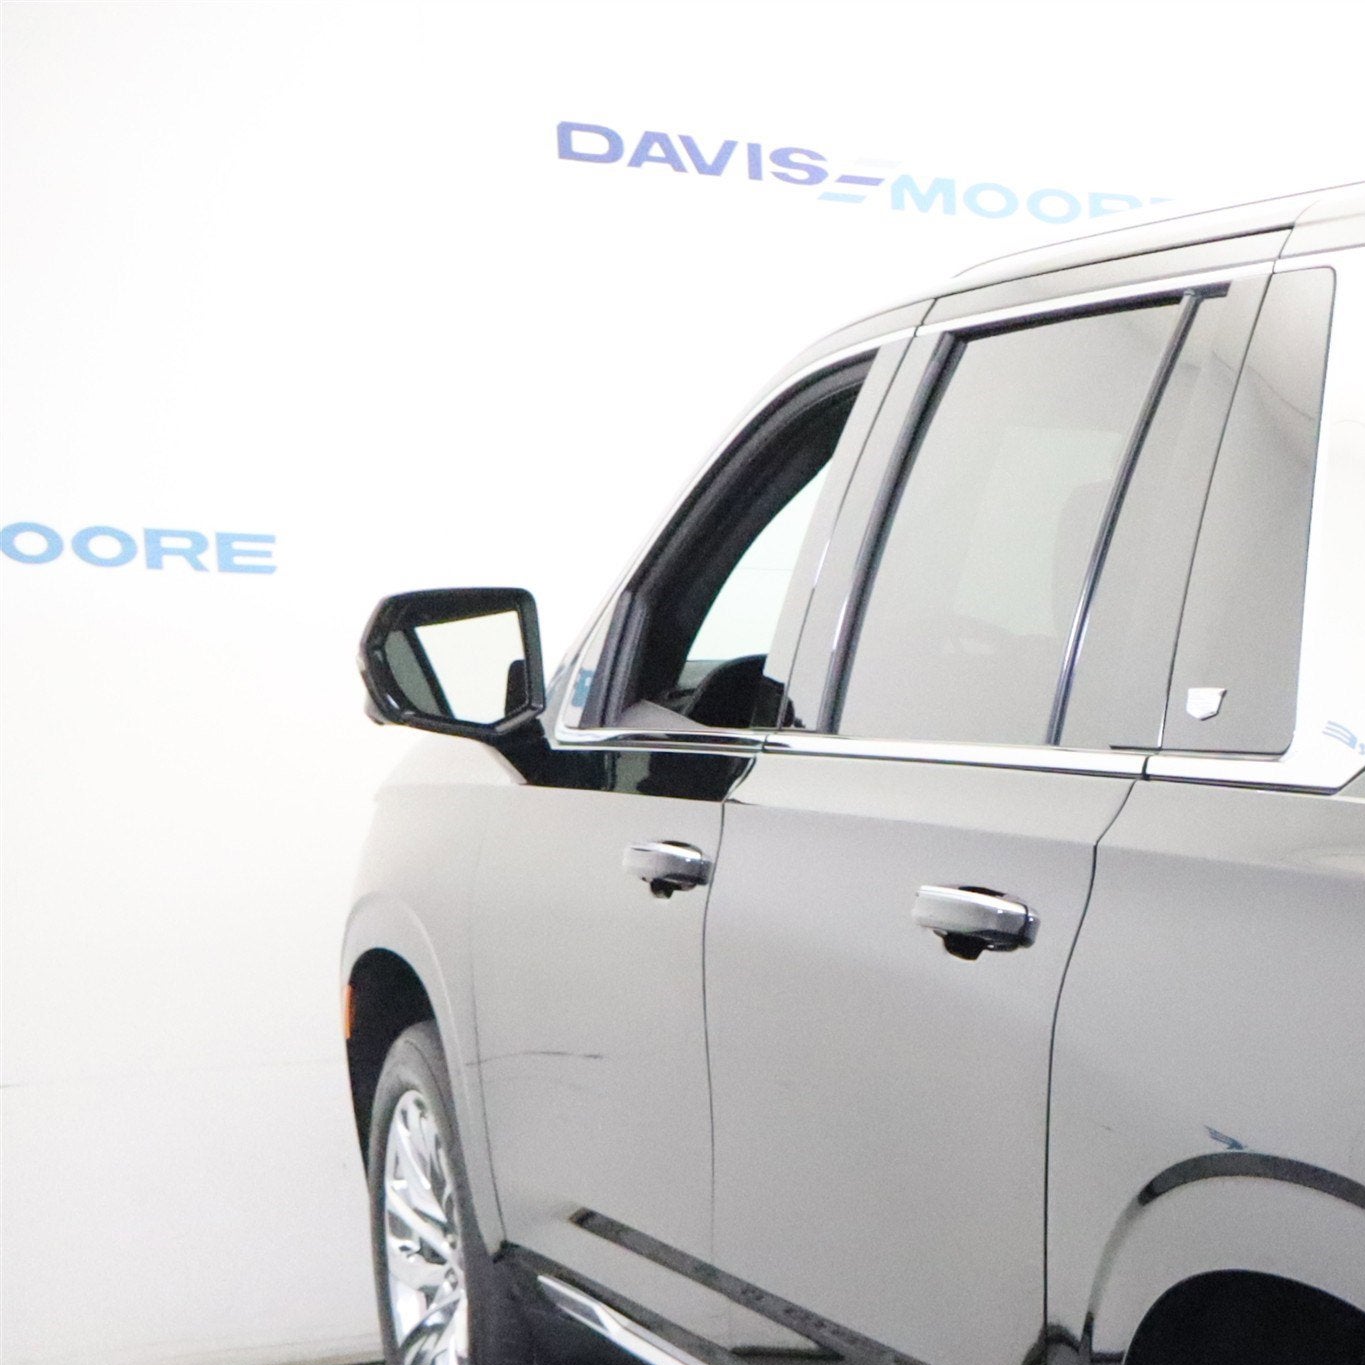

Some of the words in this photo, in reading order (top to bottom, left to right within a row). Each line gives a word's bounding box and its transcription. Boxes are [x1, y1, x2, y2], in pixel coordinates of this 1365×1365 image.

[556, 121, 829, 186] DAVIS
[890, 174, 1178, 225] MOOR
[0, 521, 278, 575] OORE
